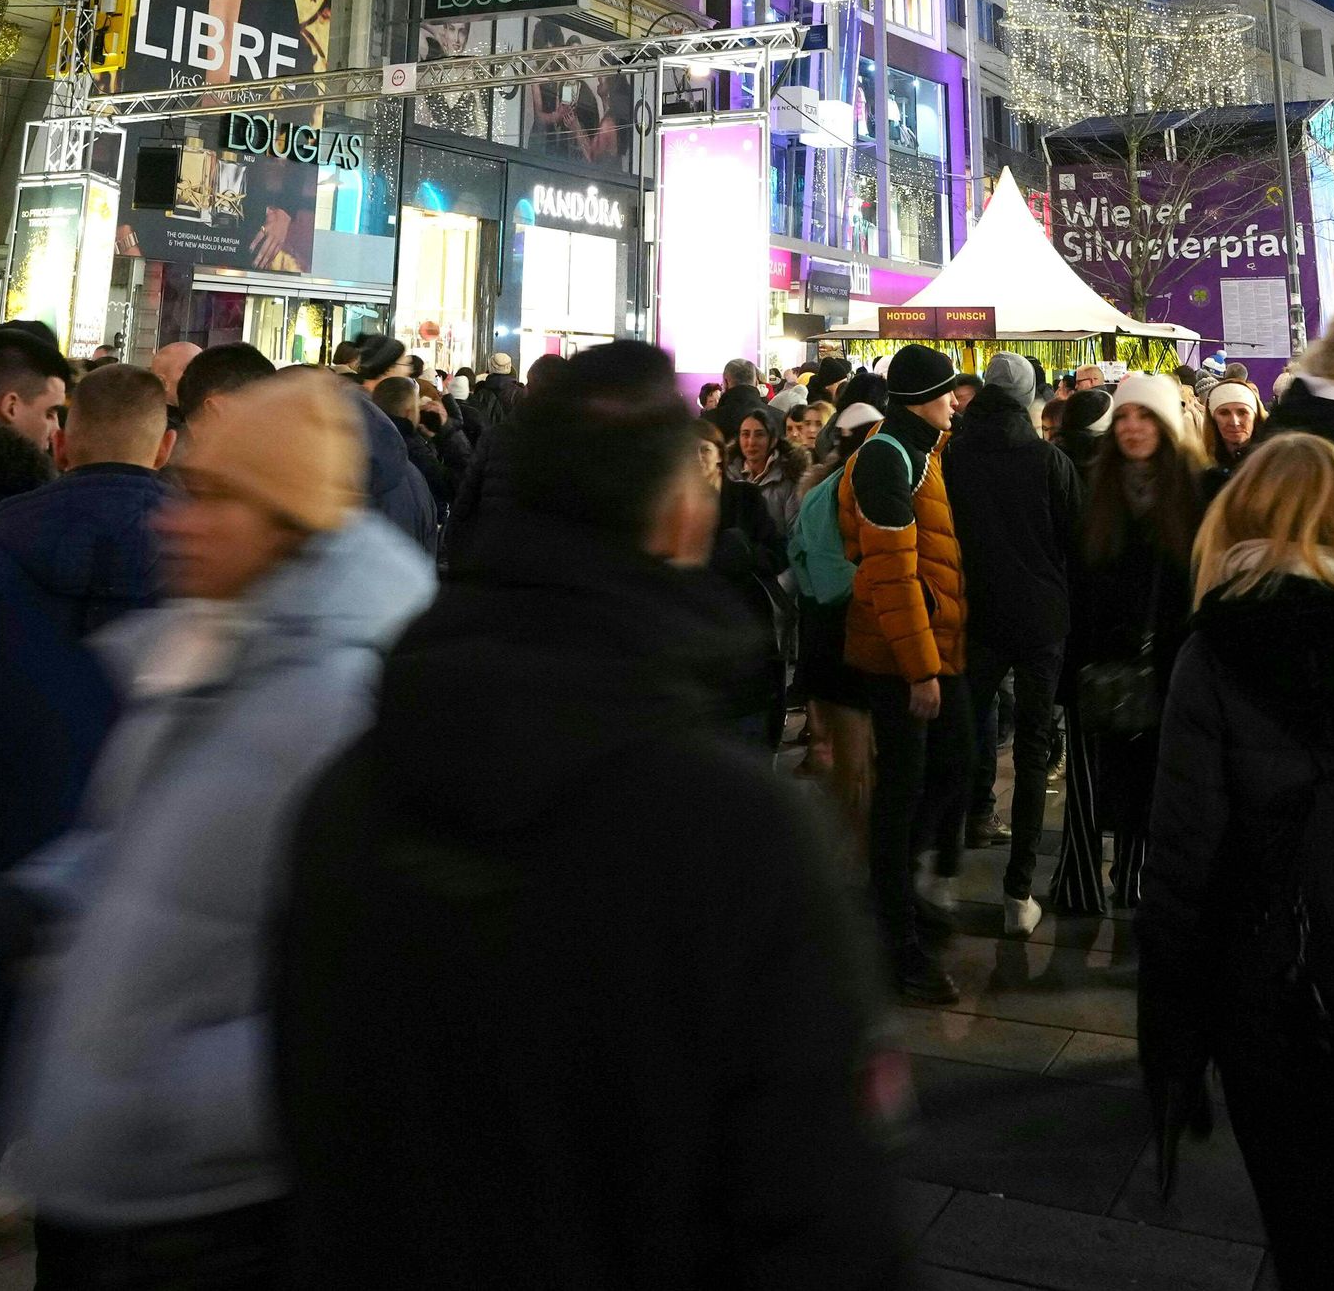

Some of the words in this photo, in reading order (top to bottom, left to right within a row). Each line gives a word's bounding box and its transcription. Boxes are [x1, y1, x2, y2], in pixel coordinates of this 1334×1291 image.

[227, 111, 363, 170] DOUGLAS
[243, 154, 256, 163] NEU
[177, 232, 202, 241] ORIGINAL
[220, 237, 240, 245] PARFUM
[174, 240, 184, 248] THE
[184, 241, 197, 249] NEW
[197, 243, 217, 251] ABSOLU
[217, 245, 237, 253] PLATINE
[1063, 223, 1306, 268] Silvesterpfad
[886, 311, 926, 321] HOTDOG
[946, 311, 986, 321] PUNSCH
